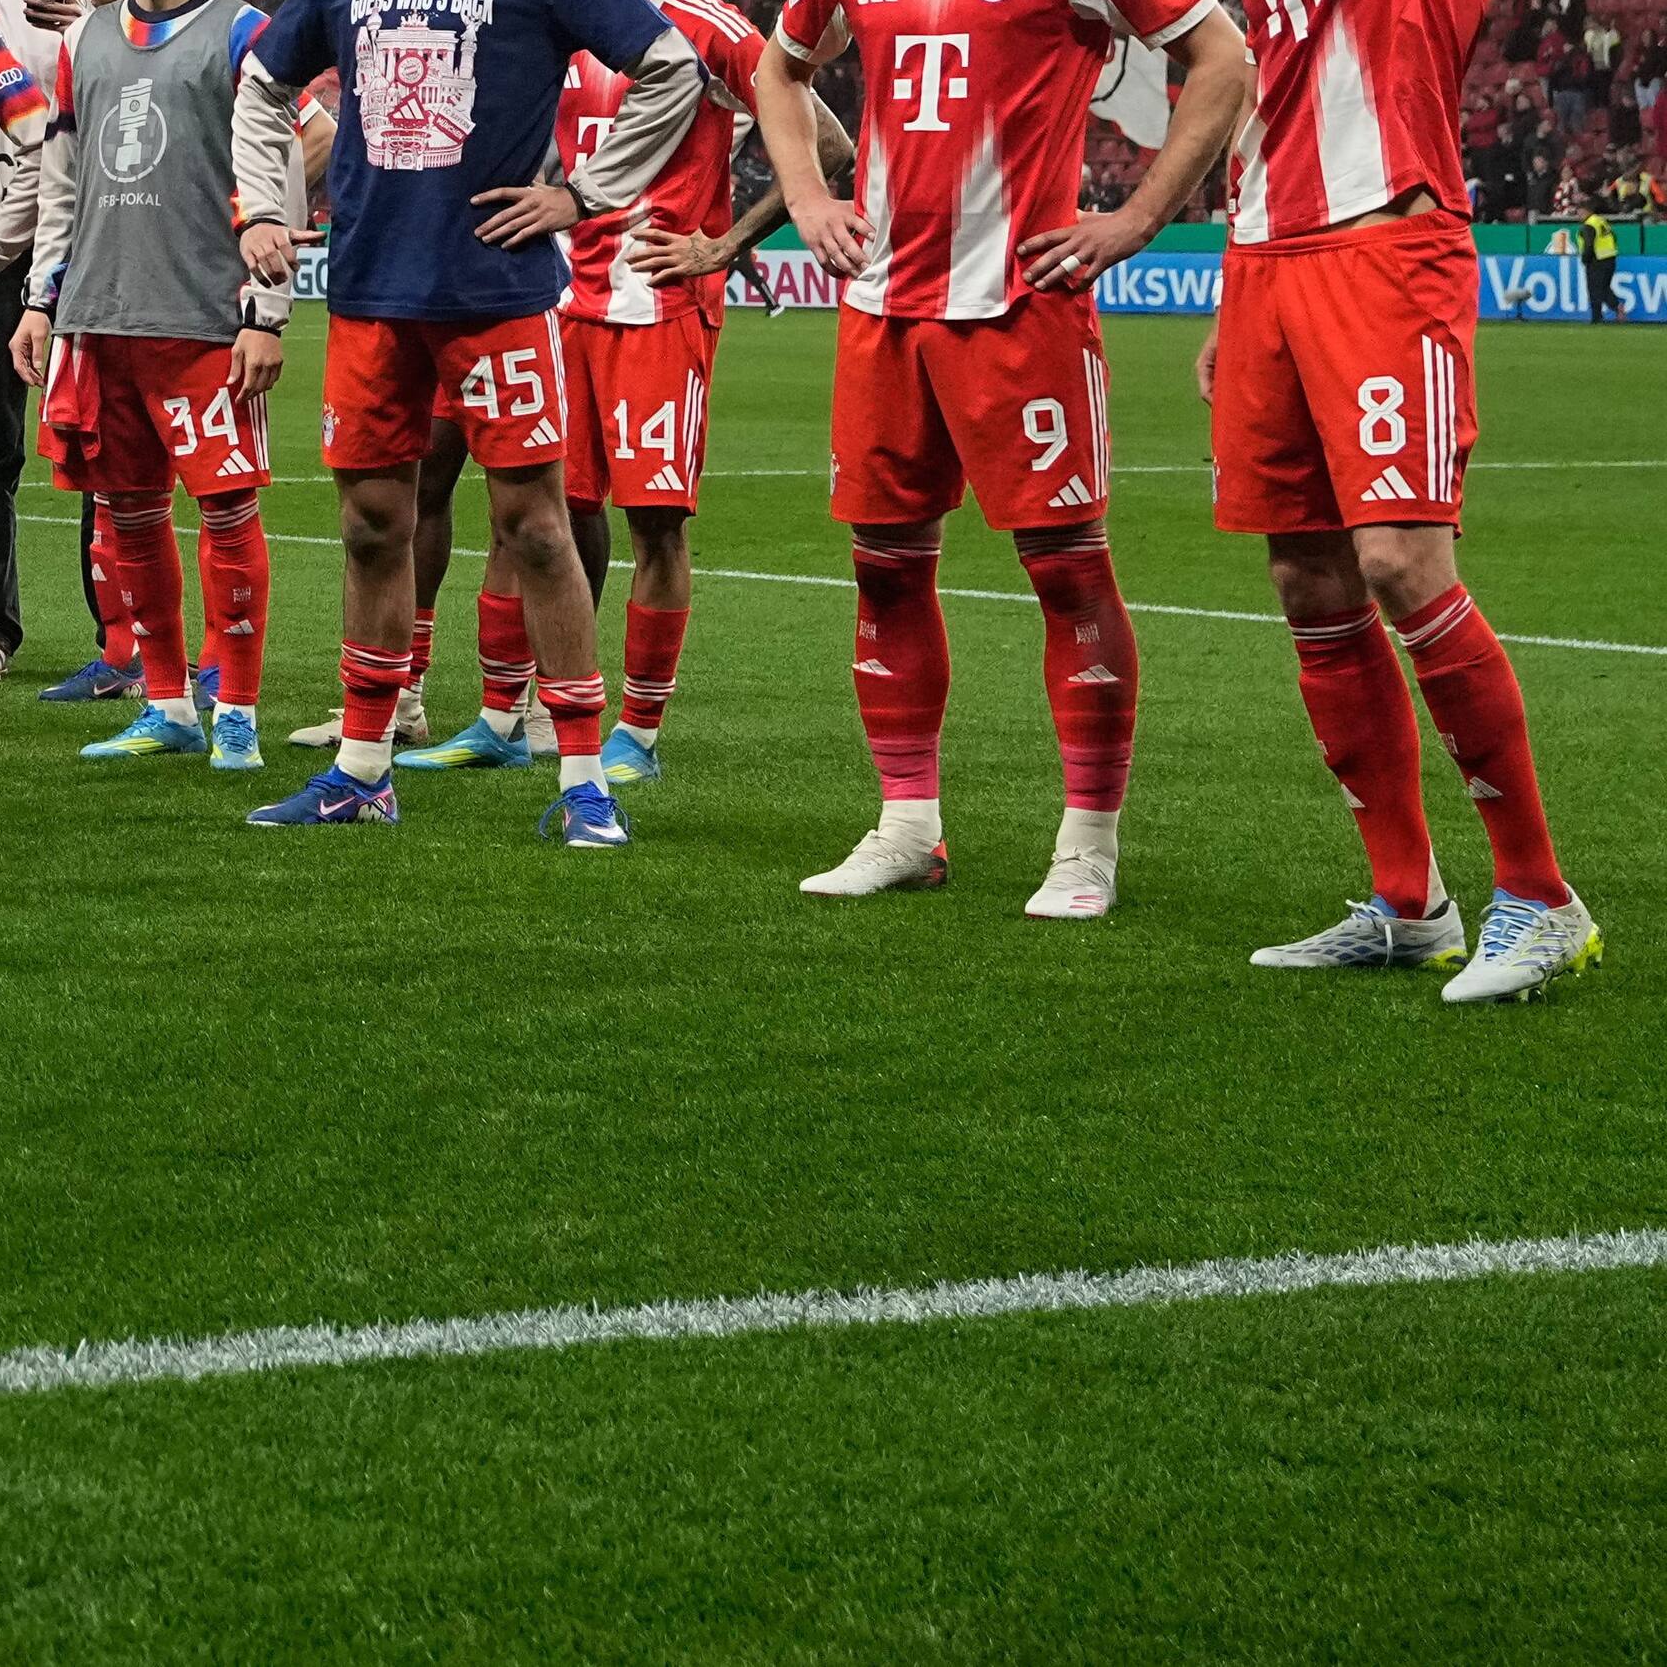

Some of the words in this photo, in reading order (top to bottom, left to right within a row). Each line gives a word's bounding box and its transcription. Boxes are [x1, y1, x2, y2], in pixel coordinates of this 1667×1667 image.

[98, 192, 161, 208] DFB-POKAL
[460, 348, 544, 420] 45
[1357, 374, 1407, 457] 8
[164, 386, 240, 457] 34
[613, 398, 677, 462] 14
[1021, 397, 1069, 472] 9
